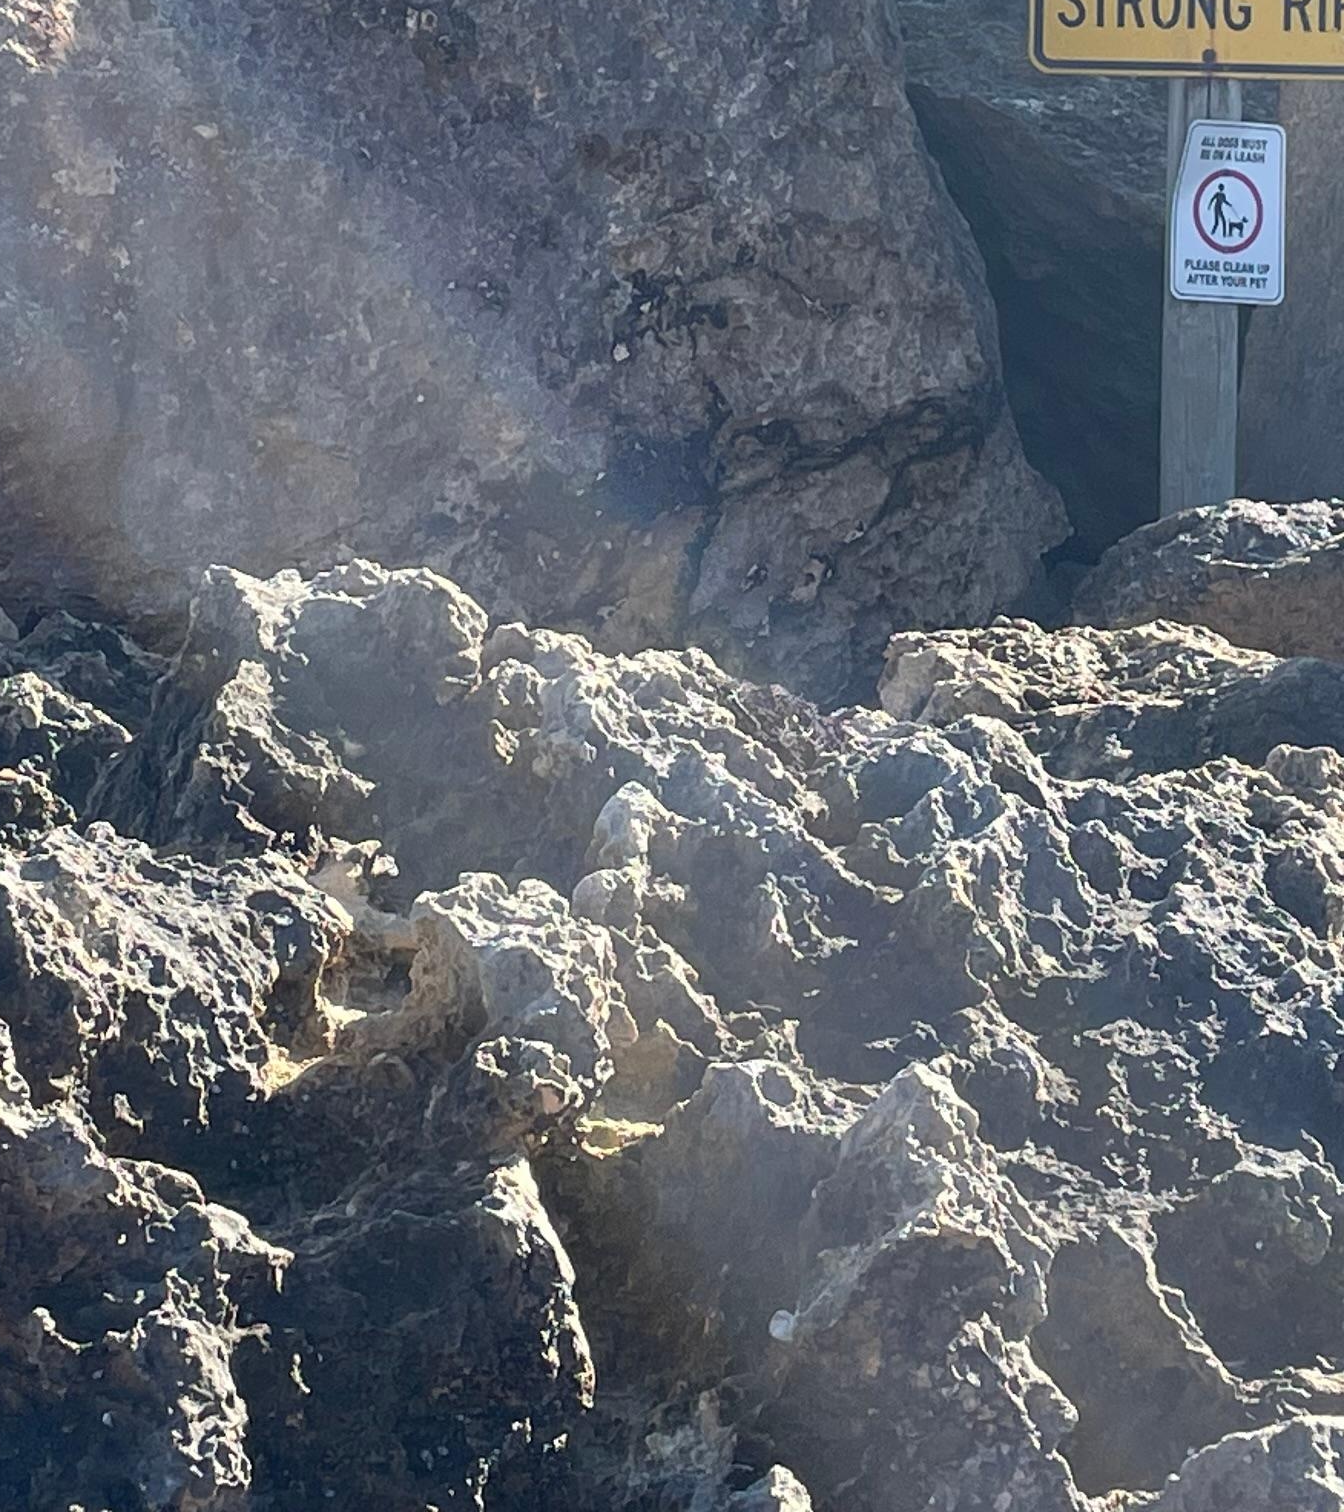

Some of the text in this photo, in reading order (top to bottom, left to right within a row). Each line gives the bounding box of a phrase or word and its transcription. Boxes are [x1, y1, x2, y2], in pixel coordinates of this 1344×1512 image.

[1201, 136, 1268, 150] ALL DOGS MUST
[1200, 149, 1265, 163] BE ON A LEASH
[1184, 259, 1270, 274] PLEASE CLEAN UP
[1186, 274, 1268, 289] AFTER YOUR PET
